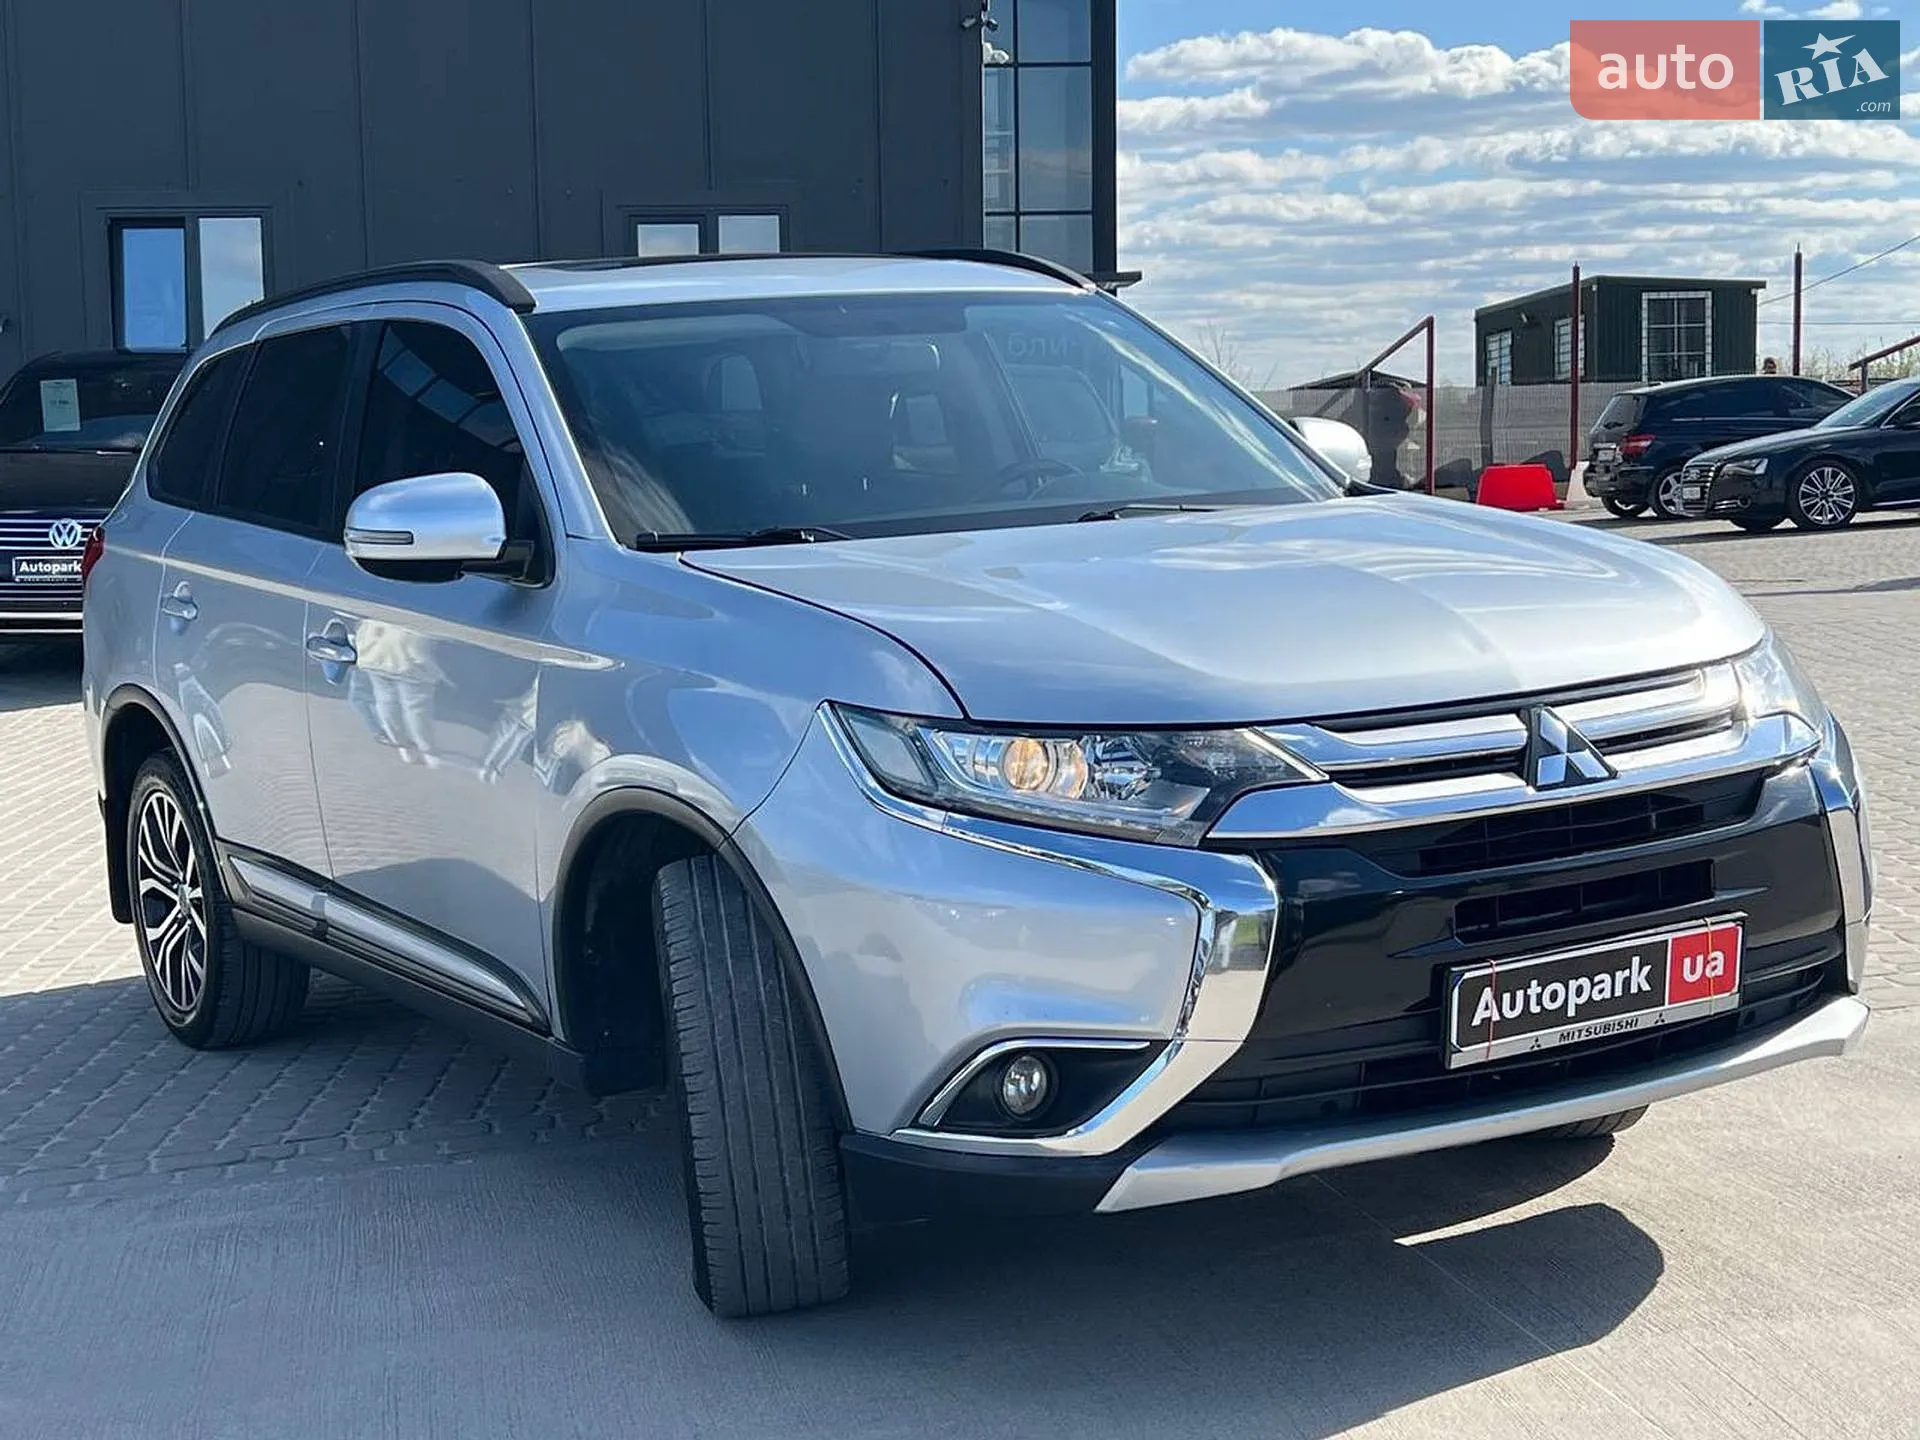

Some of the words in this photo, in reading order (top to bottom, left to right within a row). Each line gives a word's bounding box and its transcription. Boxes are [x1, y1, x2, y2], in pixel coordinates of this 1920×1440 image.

[19, 560, 82, 575] Autopark
[1471, 956, 1653, 1027] Autopark
[1682, 950, 1725, 983] ua
[1558, 1018, 1639, 1043] MITSUBISHI
